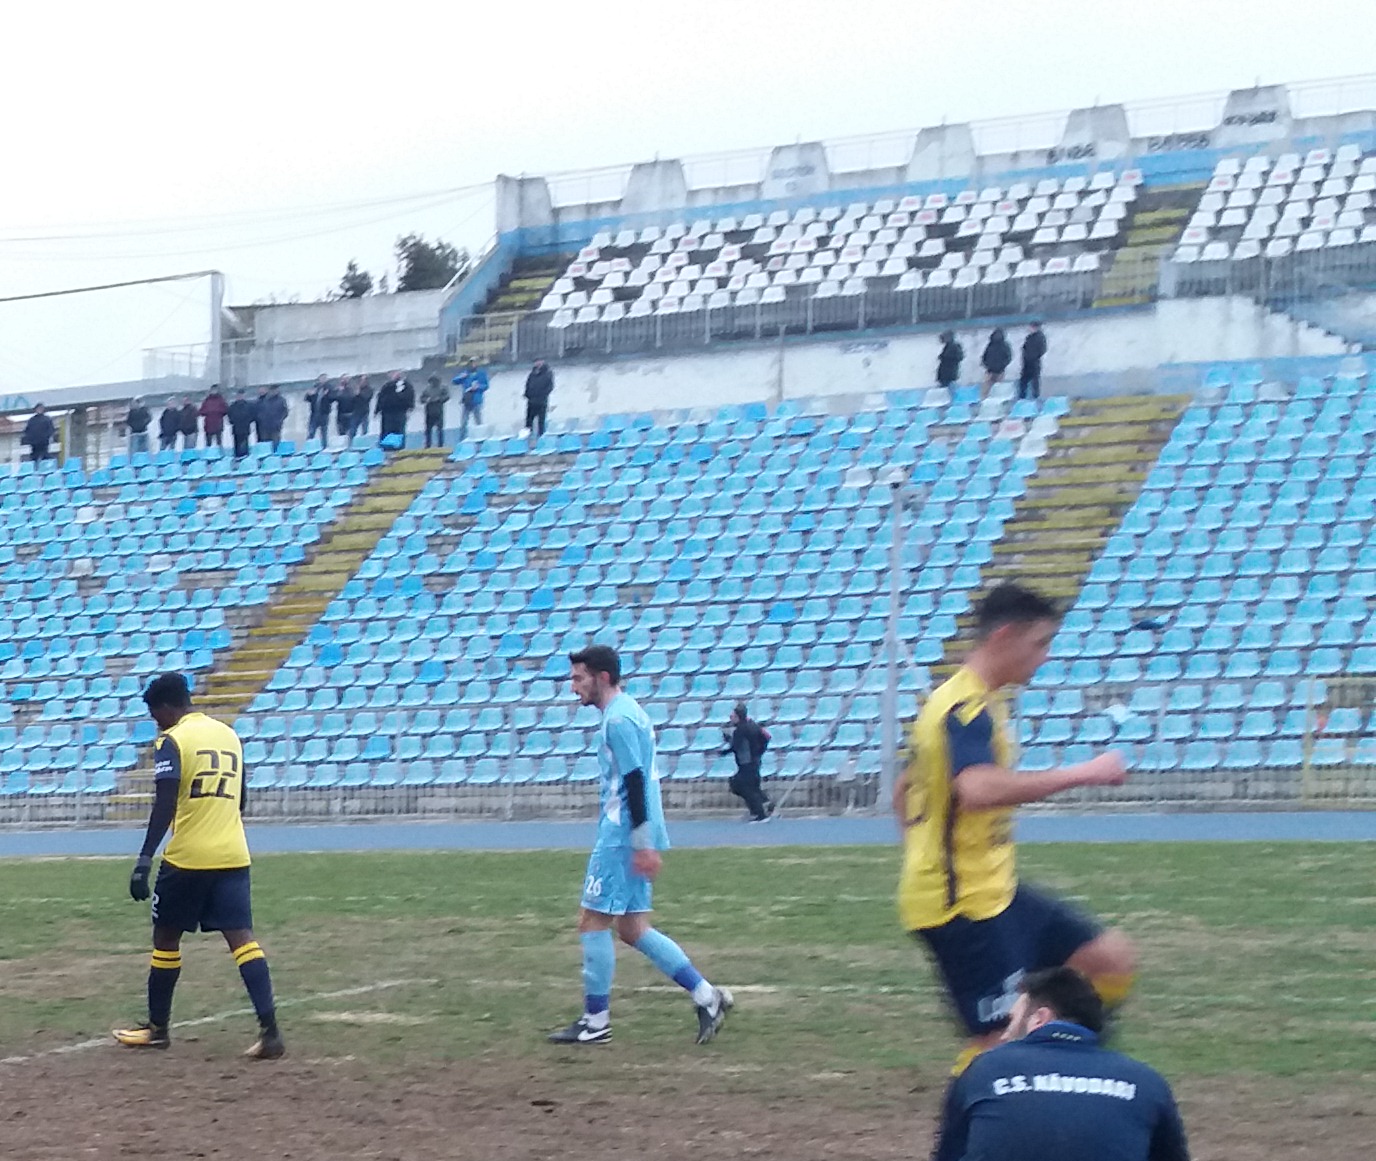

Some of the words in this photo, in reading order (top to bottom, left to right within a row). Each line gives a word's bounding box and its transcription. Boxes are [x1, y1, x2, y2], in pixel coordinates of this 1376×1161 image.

[190, 750, 238, 799] 22
[586, 875, 602, 896] 26
[993, 1075, 1032, 1096] C.S.
